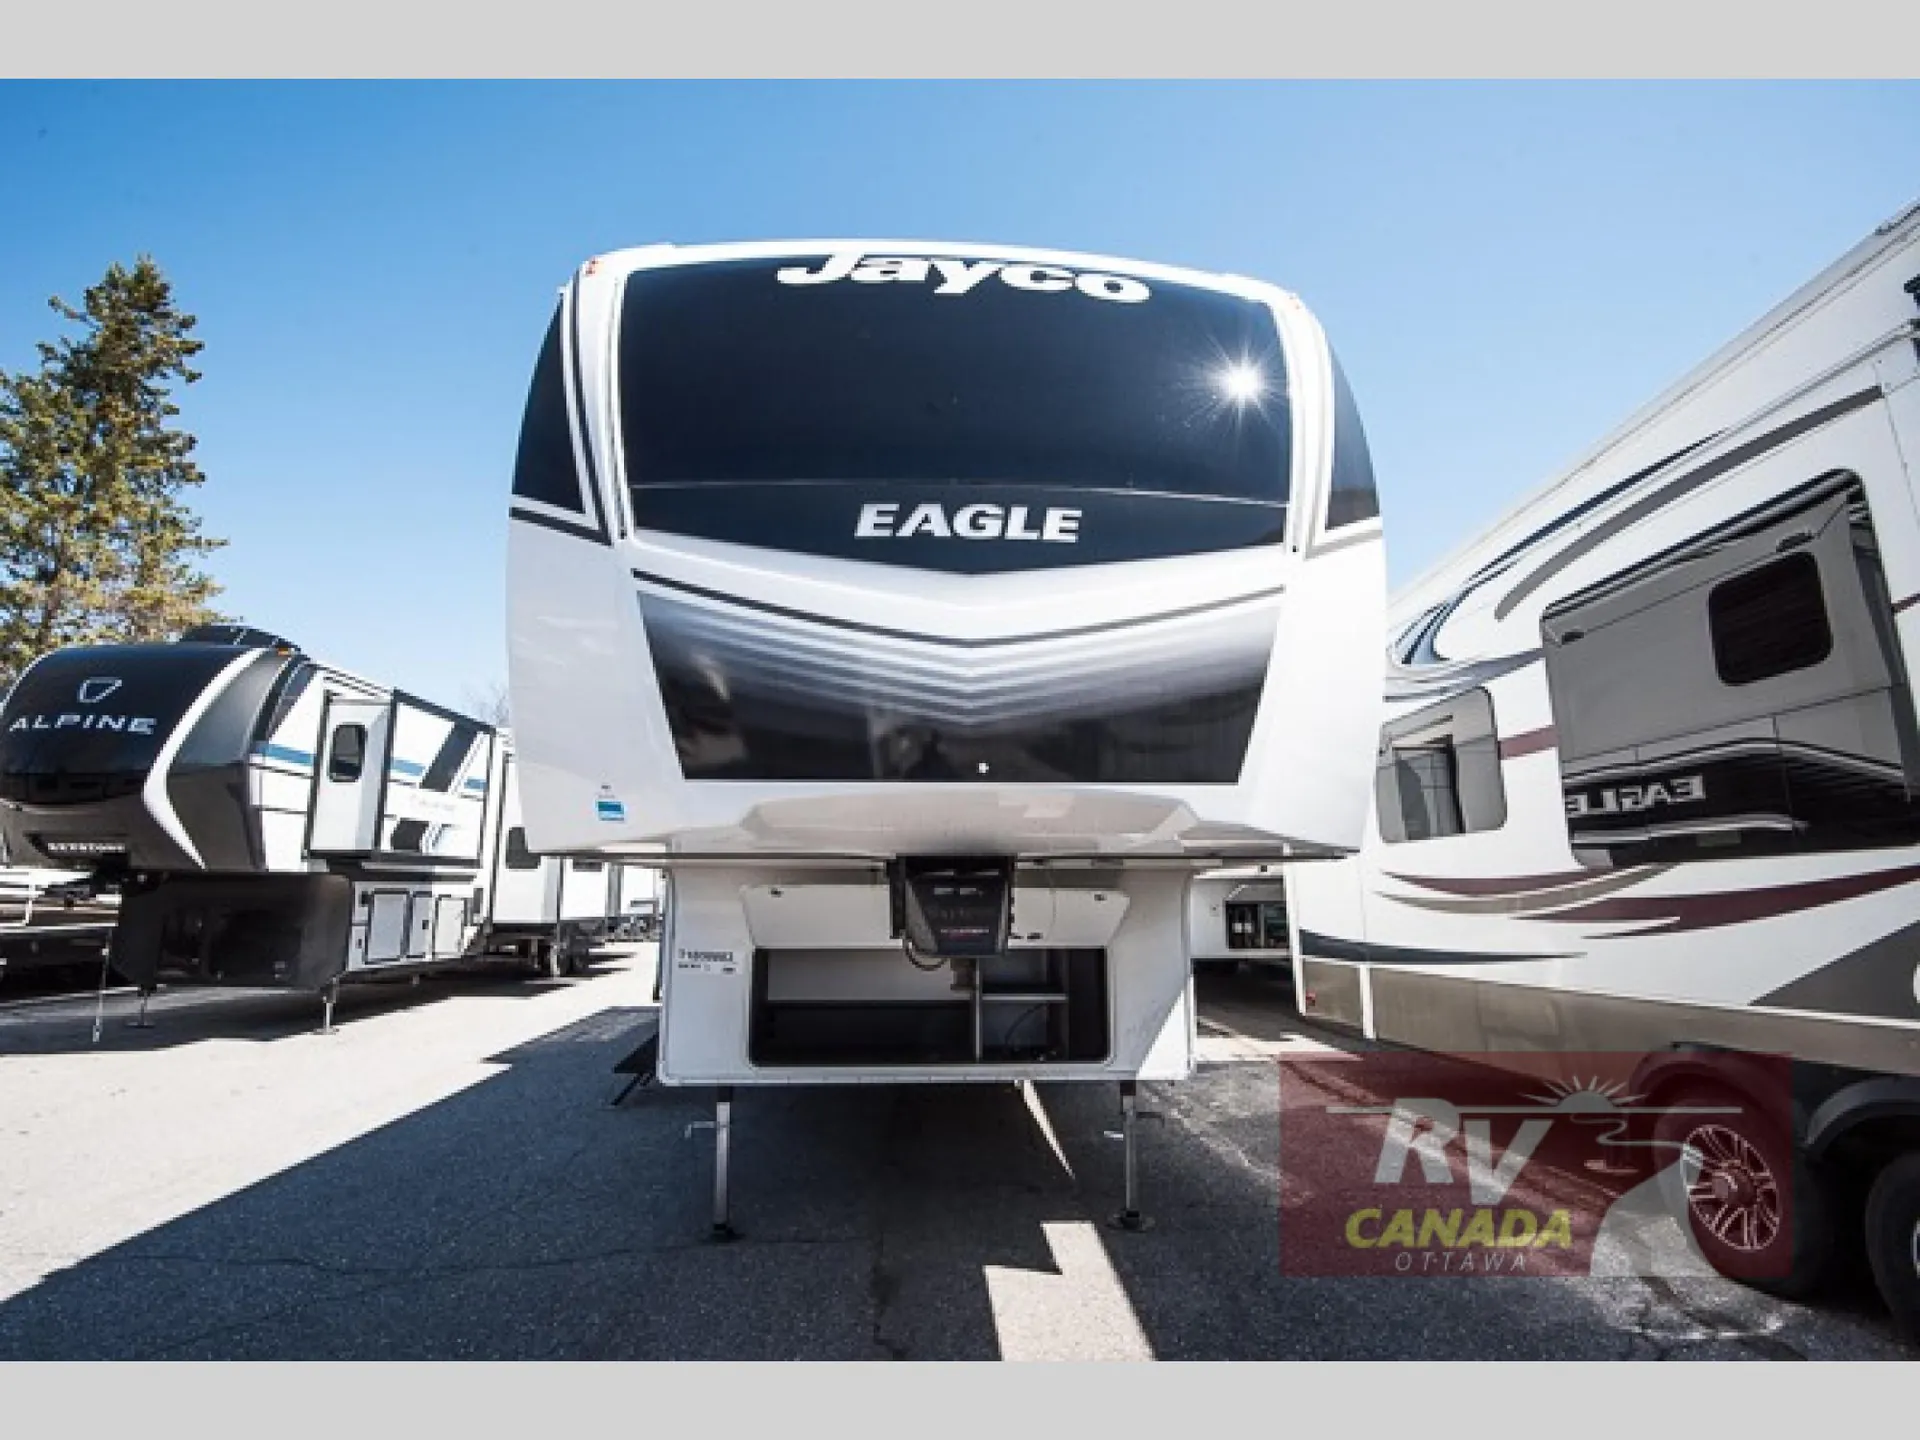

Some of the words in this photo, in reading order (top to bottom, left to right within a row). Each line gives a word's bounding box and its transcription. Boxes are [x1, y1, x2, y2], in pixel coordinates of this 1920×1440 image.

[777, 252, 1151, 303] Jayco
[854, 503, 1083, 543] EAGLE
[8, 713, 158, 735] ALPINE
